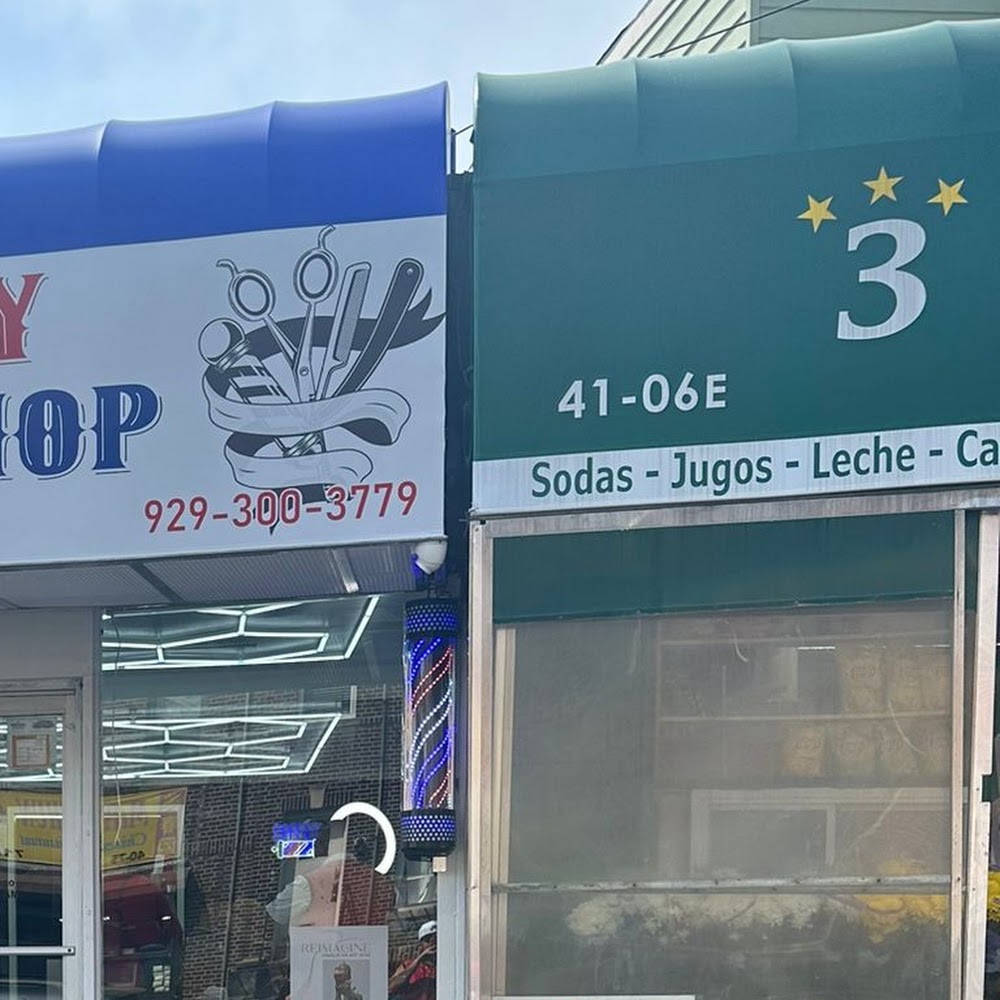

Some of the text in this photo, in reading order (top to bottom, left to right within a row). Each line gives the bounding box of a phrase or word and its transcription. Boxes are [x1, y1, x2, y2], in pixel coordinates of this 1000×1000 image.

[837, 218, 928, 340] 3
[557, 372, 728, 419] 41-06E
[531, 457, 633, 498] Sodas
[671, 451, 772, 495] Jugos
[813, 436, 915, 479] Leche
[144, 480, 418, 534] 929-300-3779
